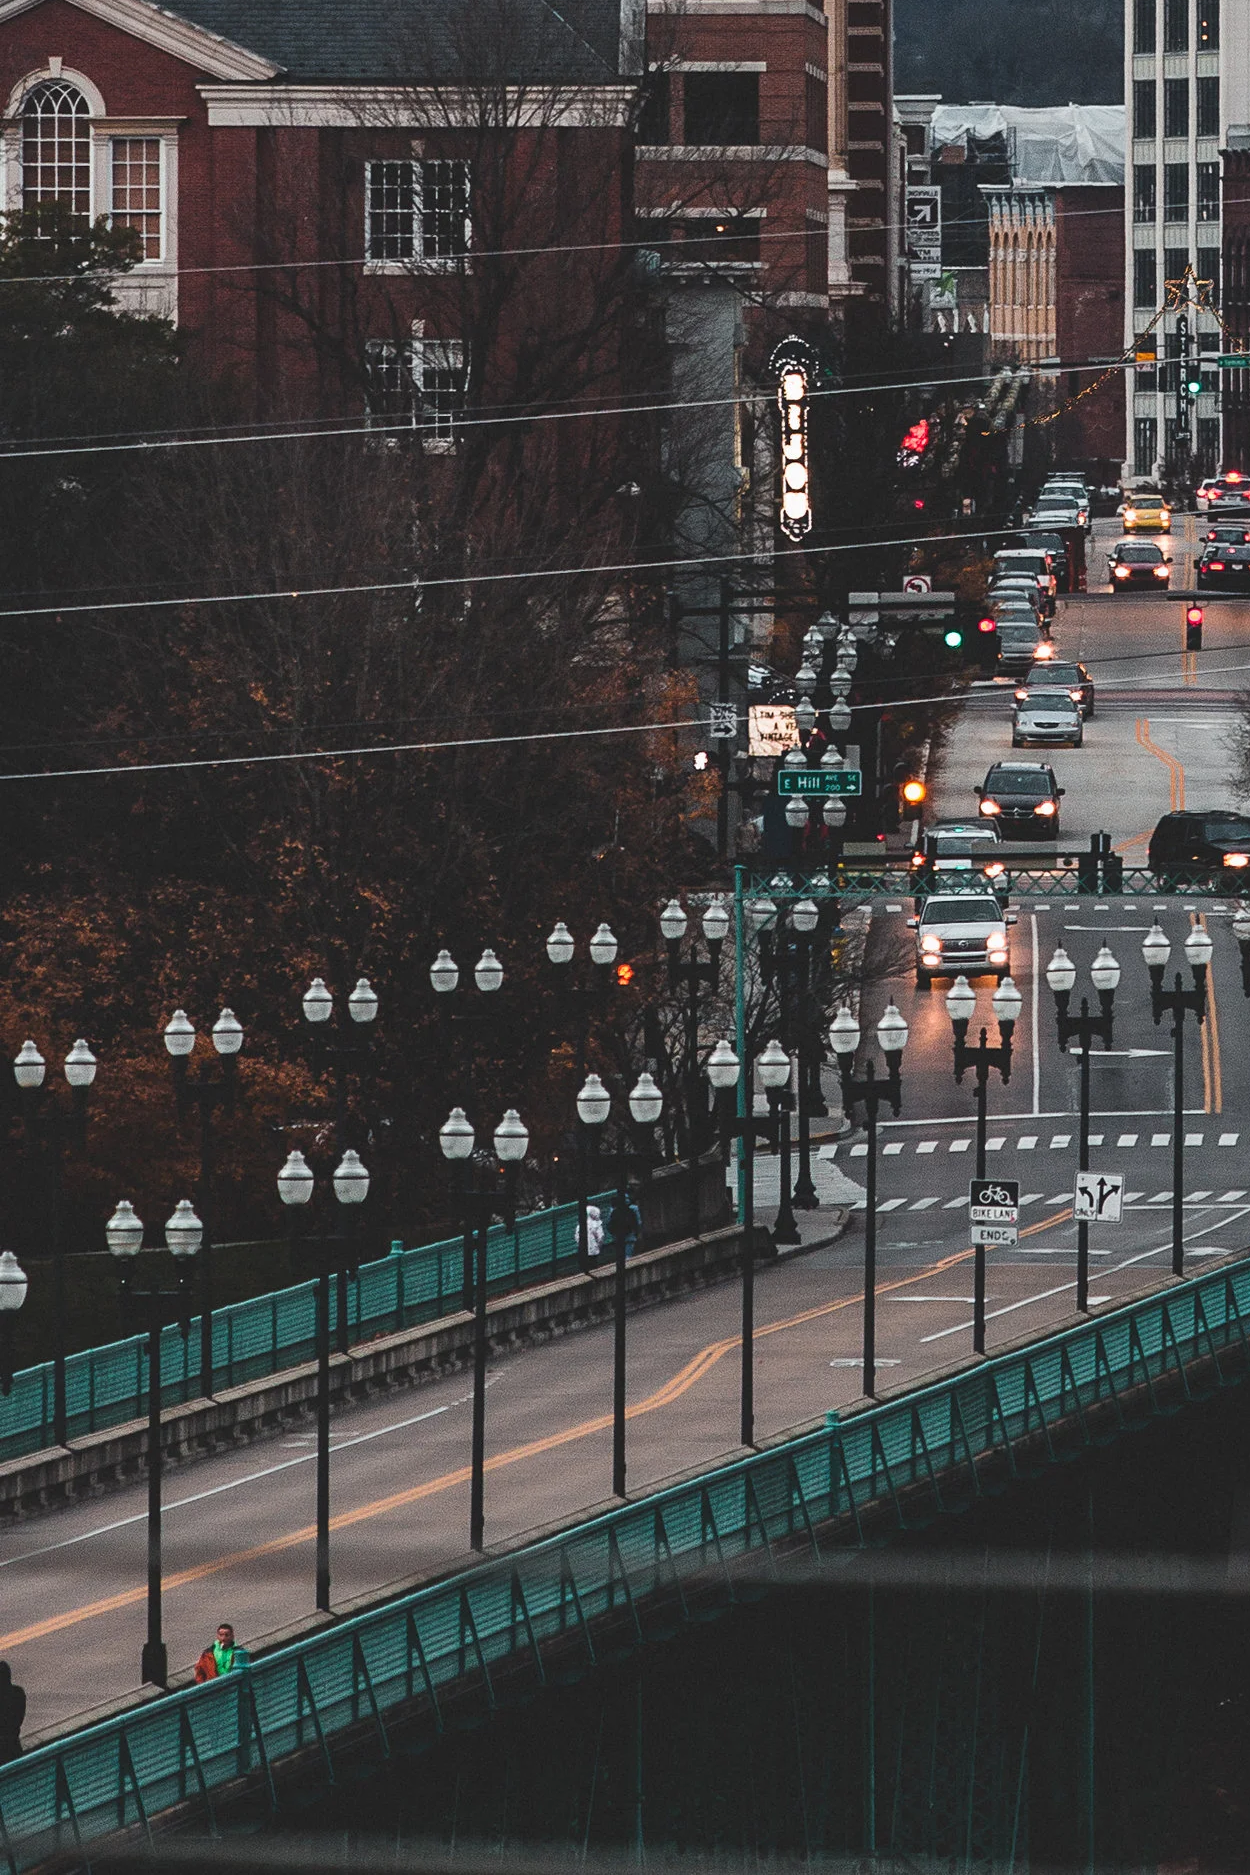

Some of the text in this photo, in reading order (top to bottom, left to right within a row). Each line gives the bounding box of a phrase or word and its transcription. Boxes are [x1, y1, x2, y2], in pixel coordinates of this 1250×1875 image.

[784, 778, 791, 789] E
[797, 776, 820, 789] Hill
[825, 774, 839, 782] AVE
[825, 784, 841, 792] 200
[972, 1208, 1015, 1219] BIKE LANE
[1076, 1208, 1096, 1217] ONLY
[980, 1229, 1009, 1241] ENDS
